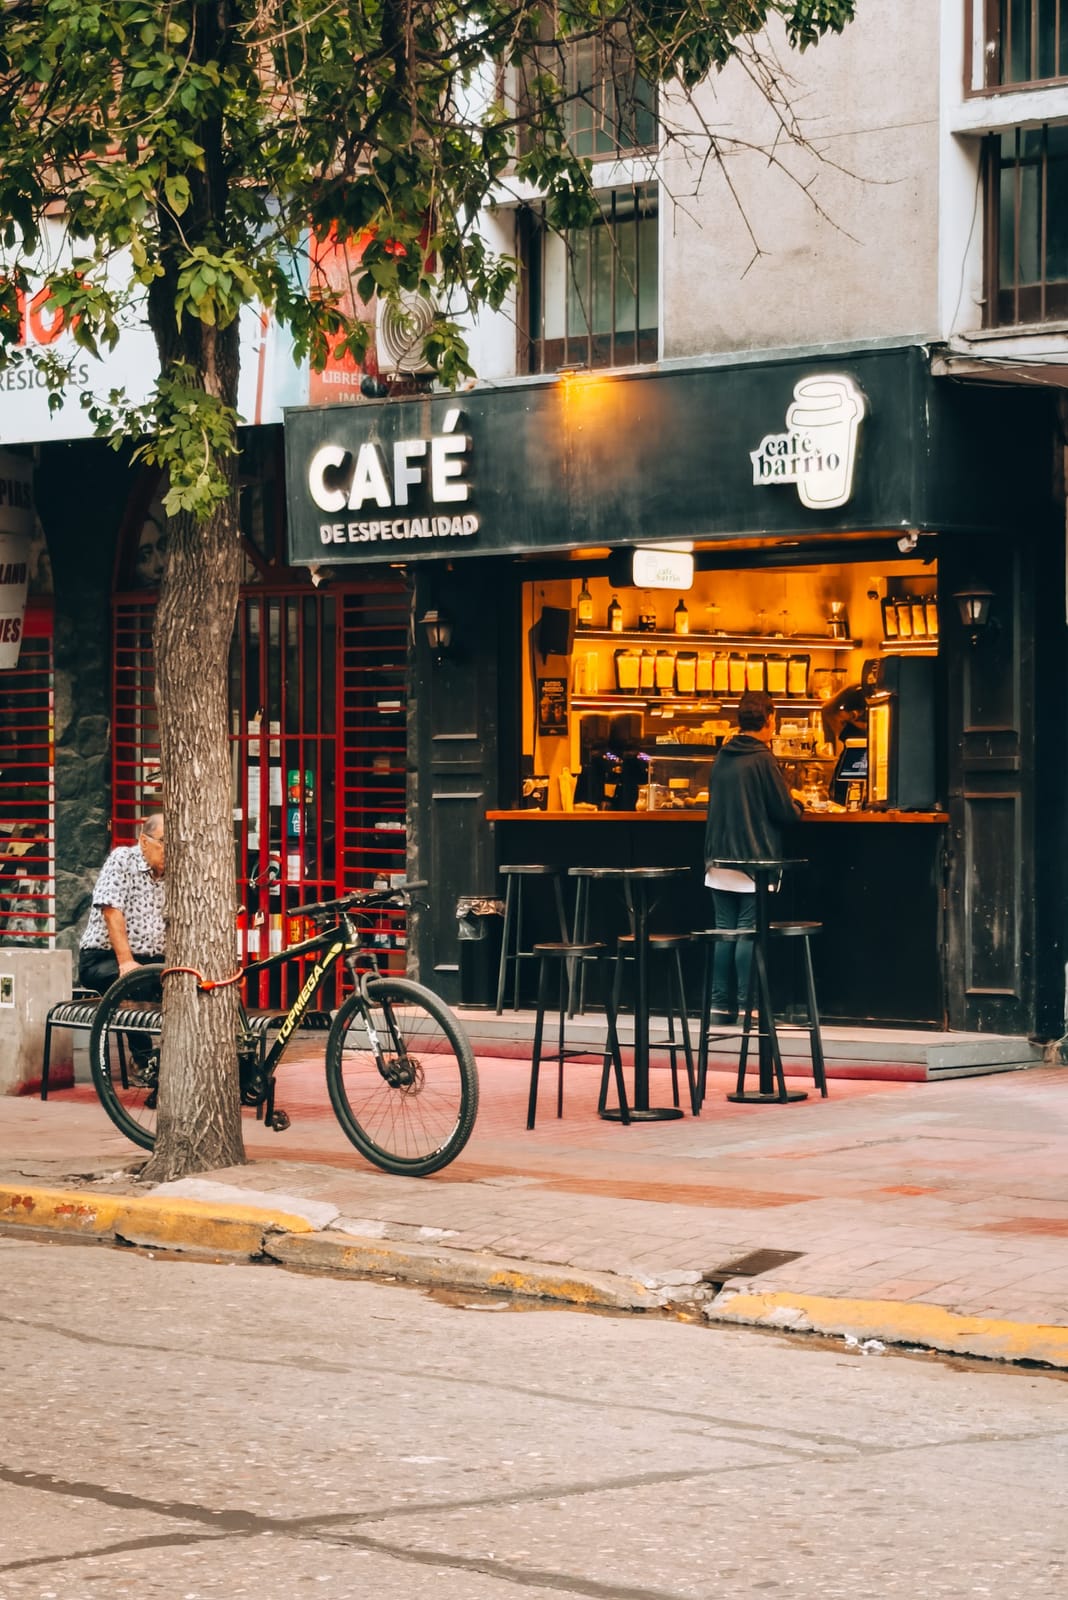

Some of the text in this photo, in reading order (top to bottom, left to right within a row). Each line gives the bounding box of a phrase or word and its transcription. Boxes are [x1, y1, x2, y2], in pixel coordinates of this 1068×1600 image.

[0, 364, 89, 391] RESIOES
[765, 432, 811, 457] café
[309, 408, 469, 512] CAFÉ
[758, 448, 840, 477] barrio
[320, 514, 479, 544] DE ESPECIALIDAD
[277, 964, 324, 1045] TOPMEGA
